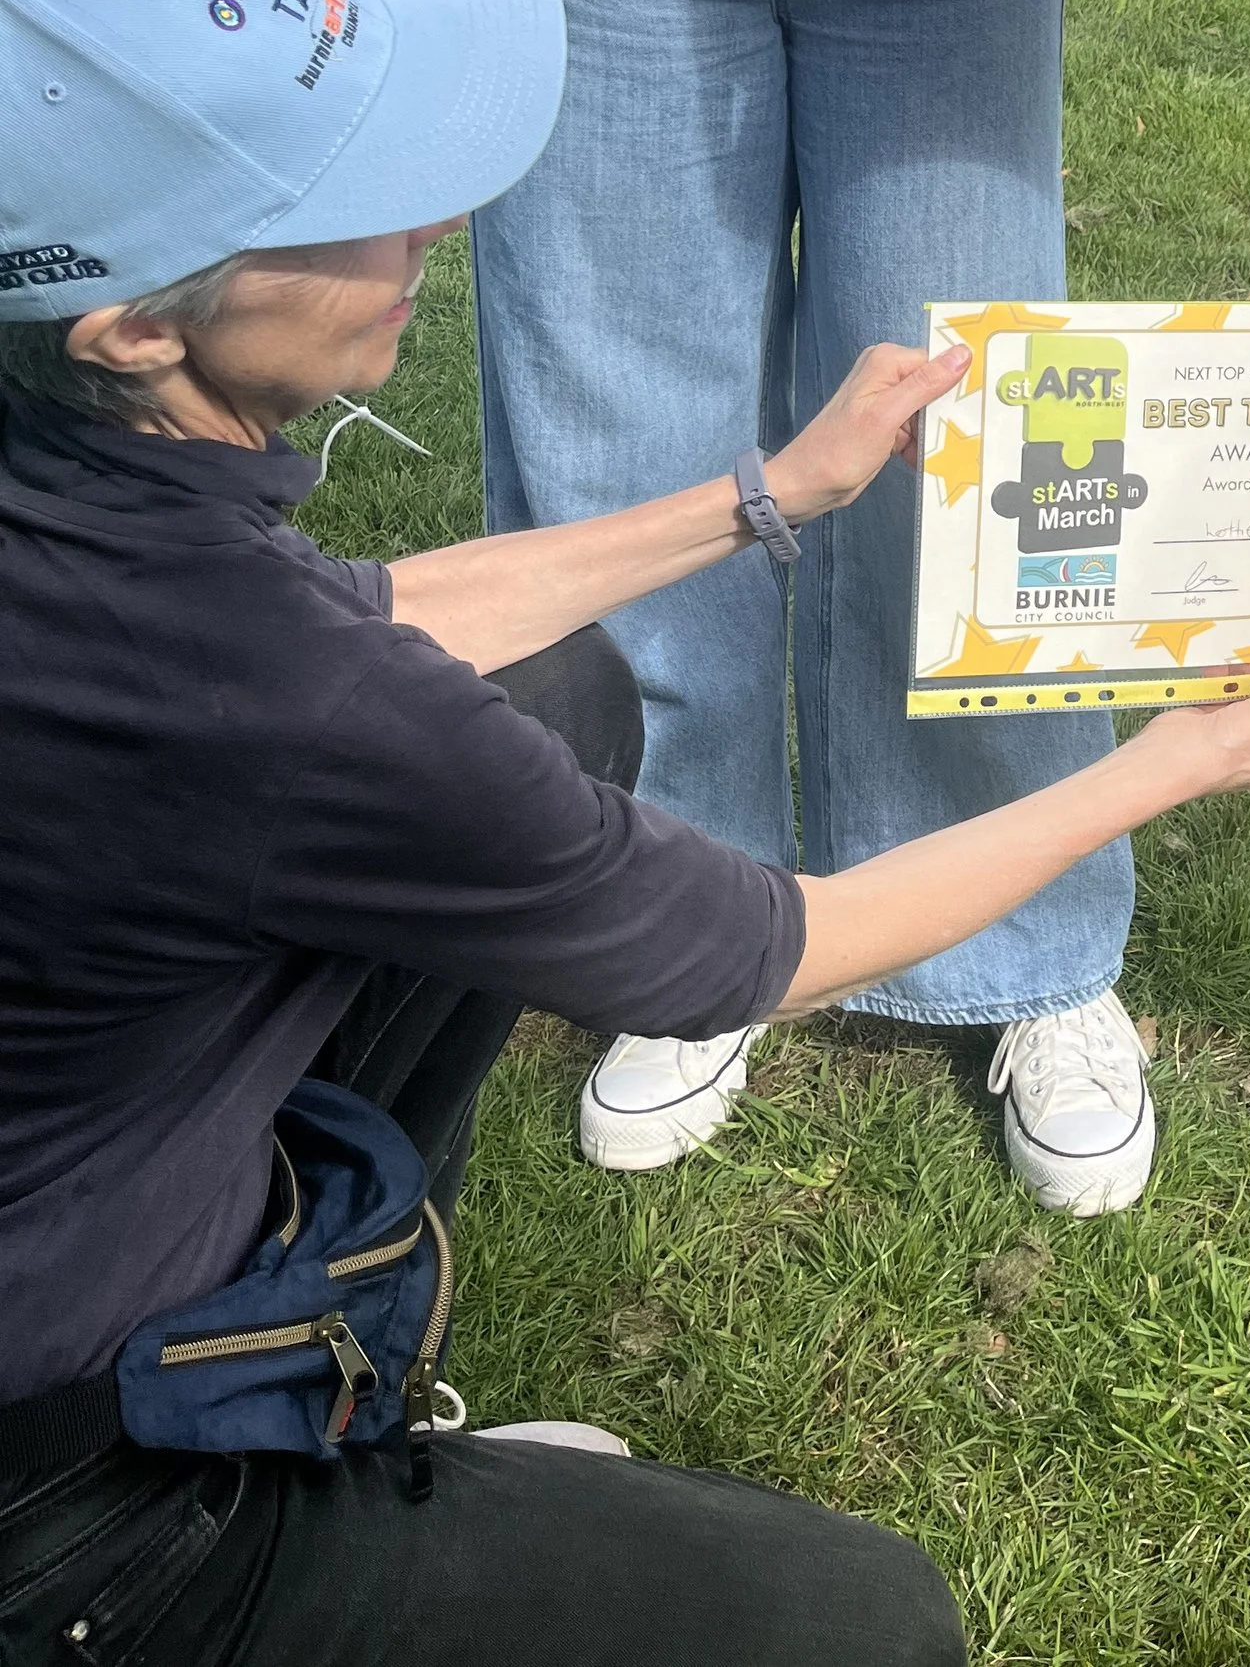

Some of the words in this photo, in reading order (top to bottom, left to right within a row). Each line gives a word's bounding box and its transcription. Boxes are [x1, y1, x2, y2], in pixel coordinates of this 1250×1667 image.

[1008, 365, 1127, 400] stARTs
[1174, 366, 1212, 381] NEXT
[1217, 366, 1245, 381] TOP
[1142, 397, 1233, 429] BEST
[1032, 477, 1119, 504] stARTs
[1127, 485, 1139, 498] in
[1037, 502, 1115, 531] March
[1015, 587, 1116, 610] BURNIE
[1182, 595, 1206, 606] Judge
[1015, 613, 1043, 623] CITY
[1055, 610, 1115, 622] COUNCIL
